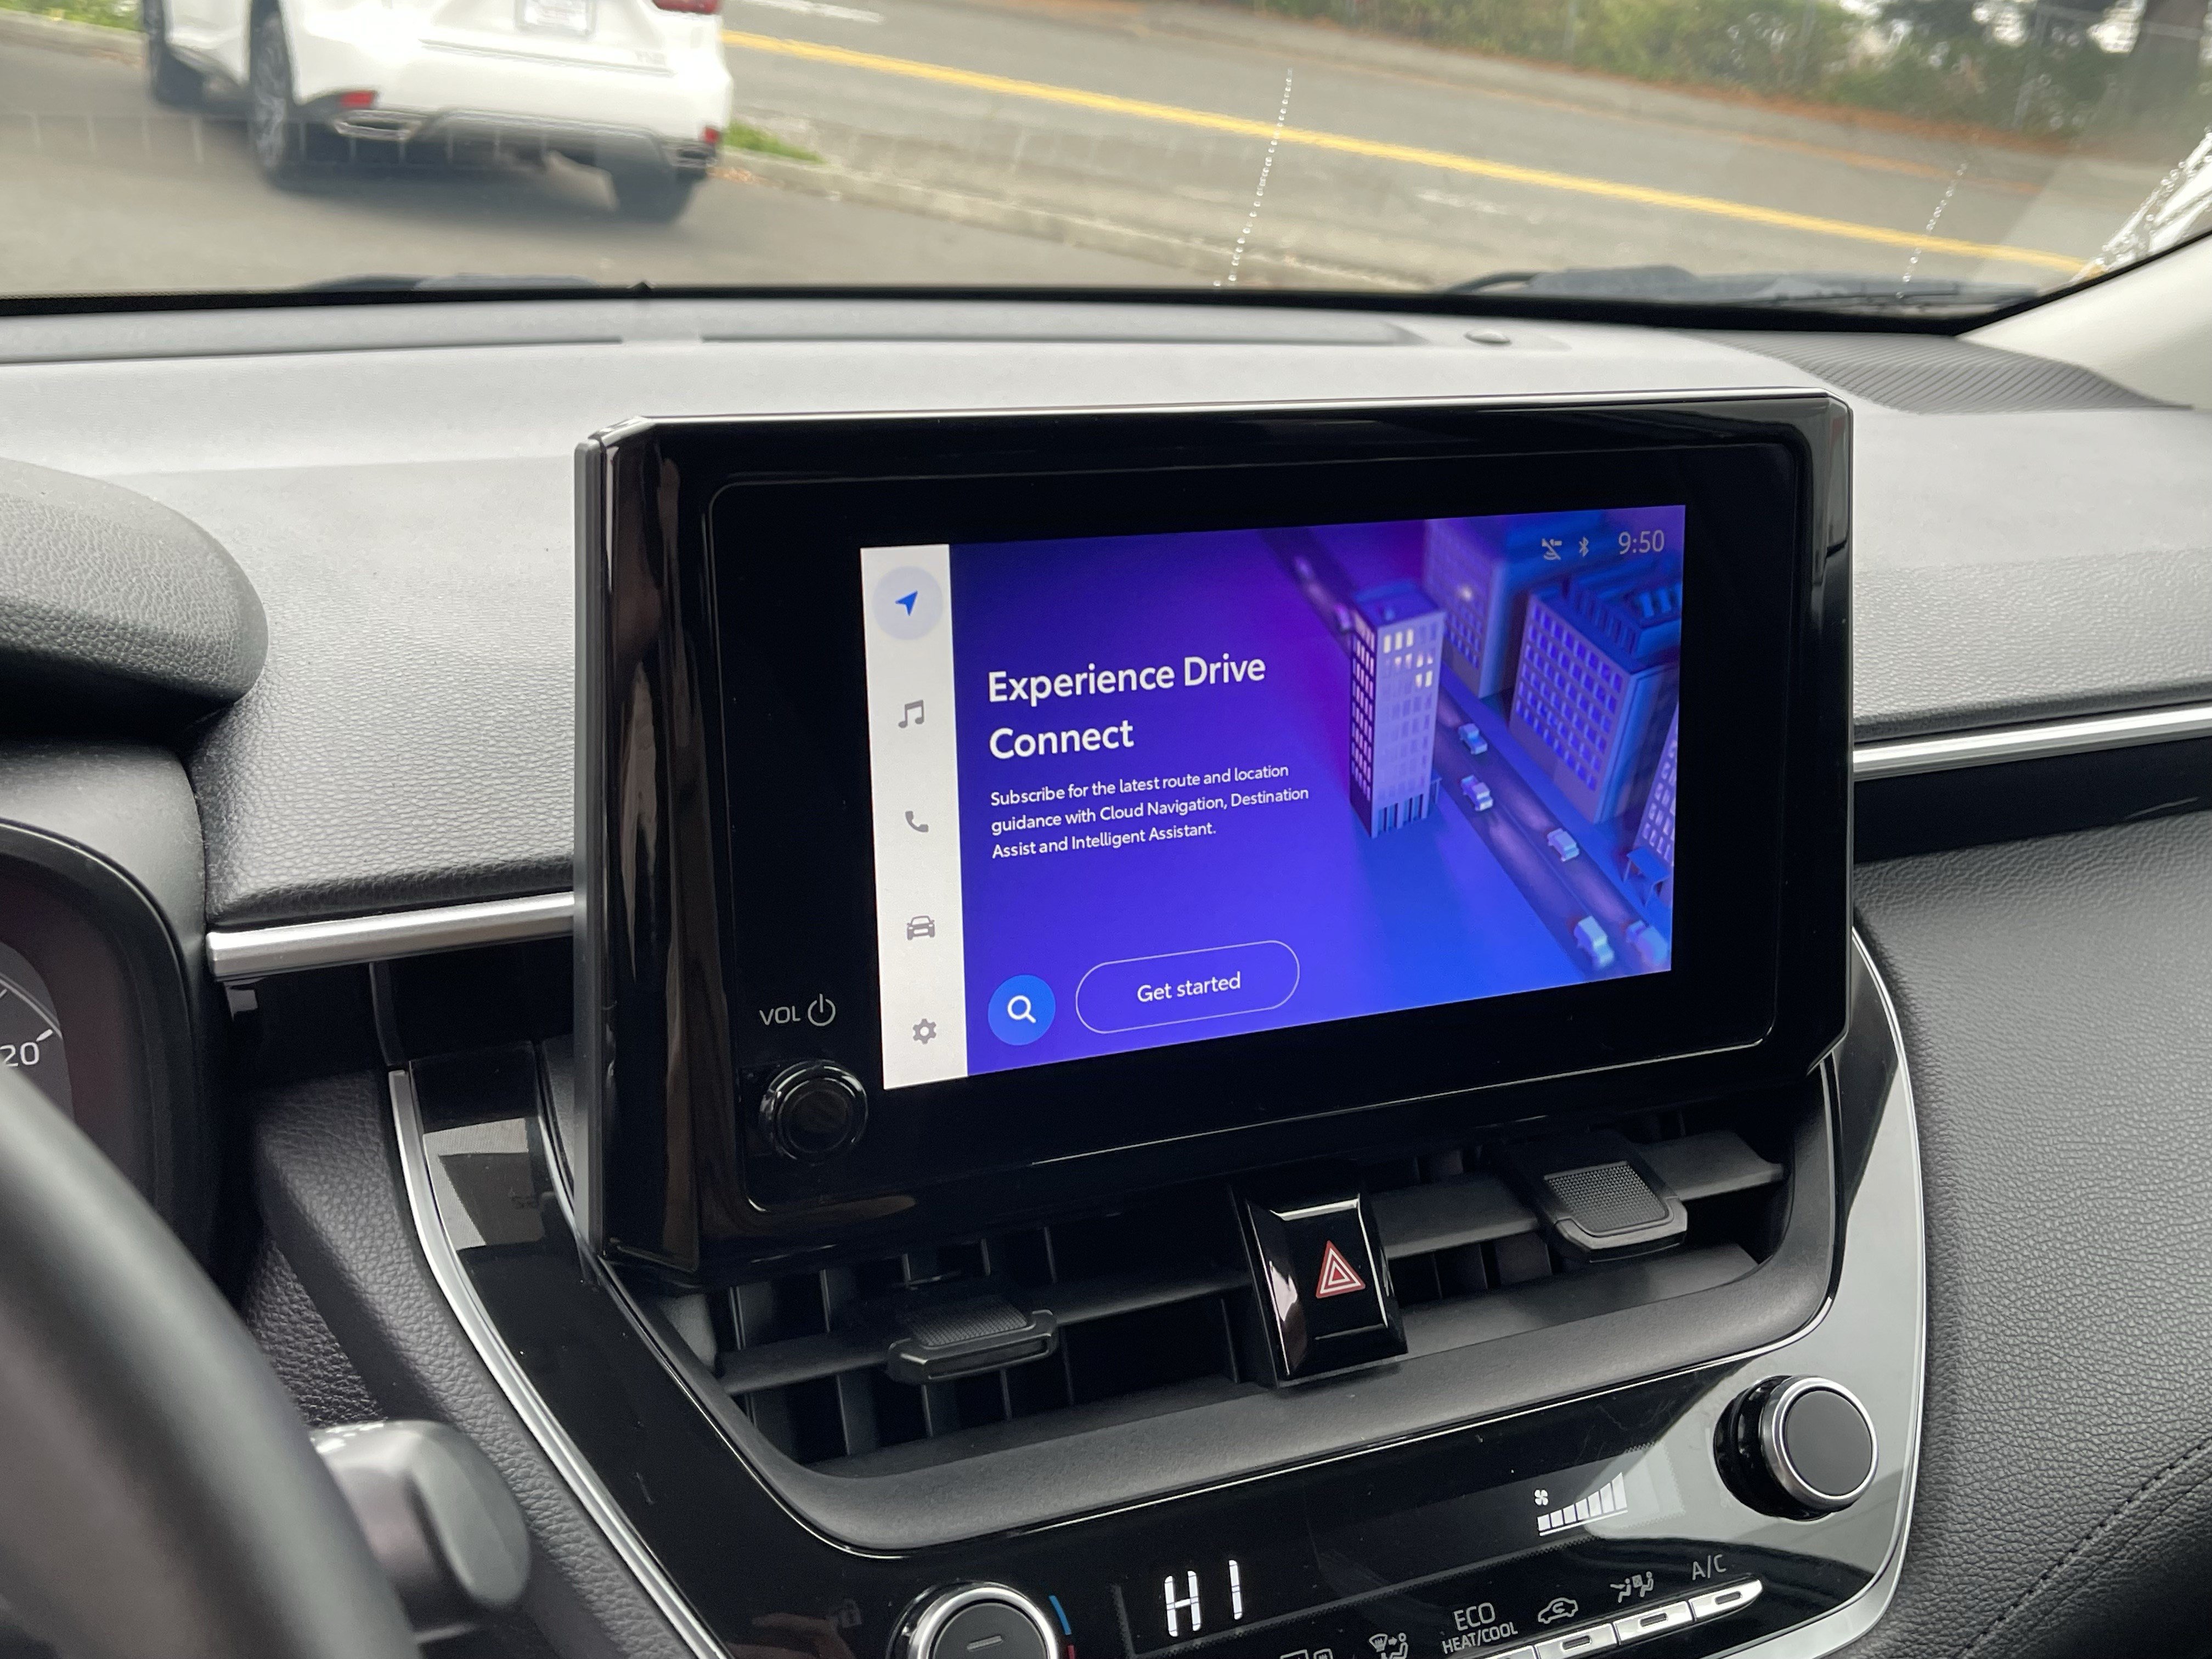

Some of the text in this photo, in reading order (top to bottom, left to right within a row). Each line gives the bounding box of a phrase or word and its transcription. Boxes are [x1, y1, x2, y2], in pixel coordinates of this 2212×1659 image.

[1618, 529, 1664, 555] 9:50
[989, 652, 1266, 707] Experience Drive
[989, 720, 1135, 759] Connect
[991, 765, 1289, 806] Subscribe for the latest route and location
[991, 788, 1309, 836] guidance with Cloud Navigation, Destination
[992, 822, 1216, 859] Assist and Intelligent Assistant.
[1137, 970, 1241, 1002] Get started
[759, 1006, 801, 1025] VOL
[1692, 1554, 1727, 1580] A/C
[1453, 1602, 1495, 1631] ECO
[1442, 1622, 1518, 1654] HEAT/COOL
